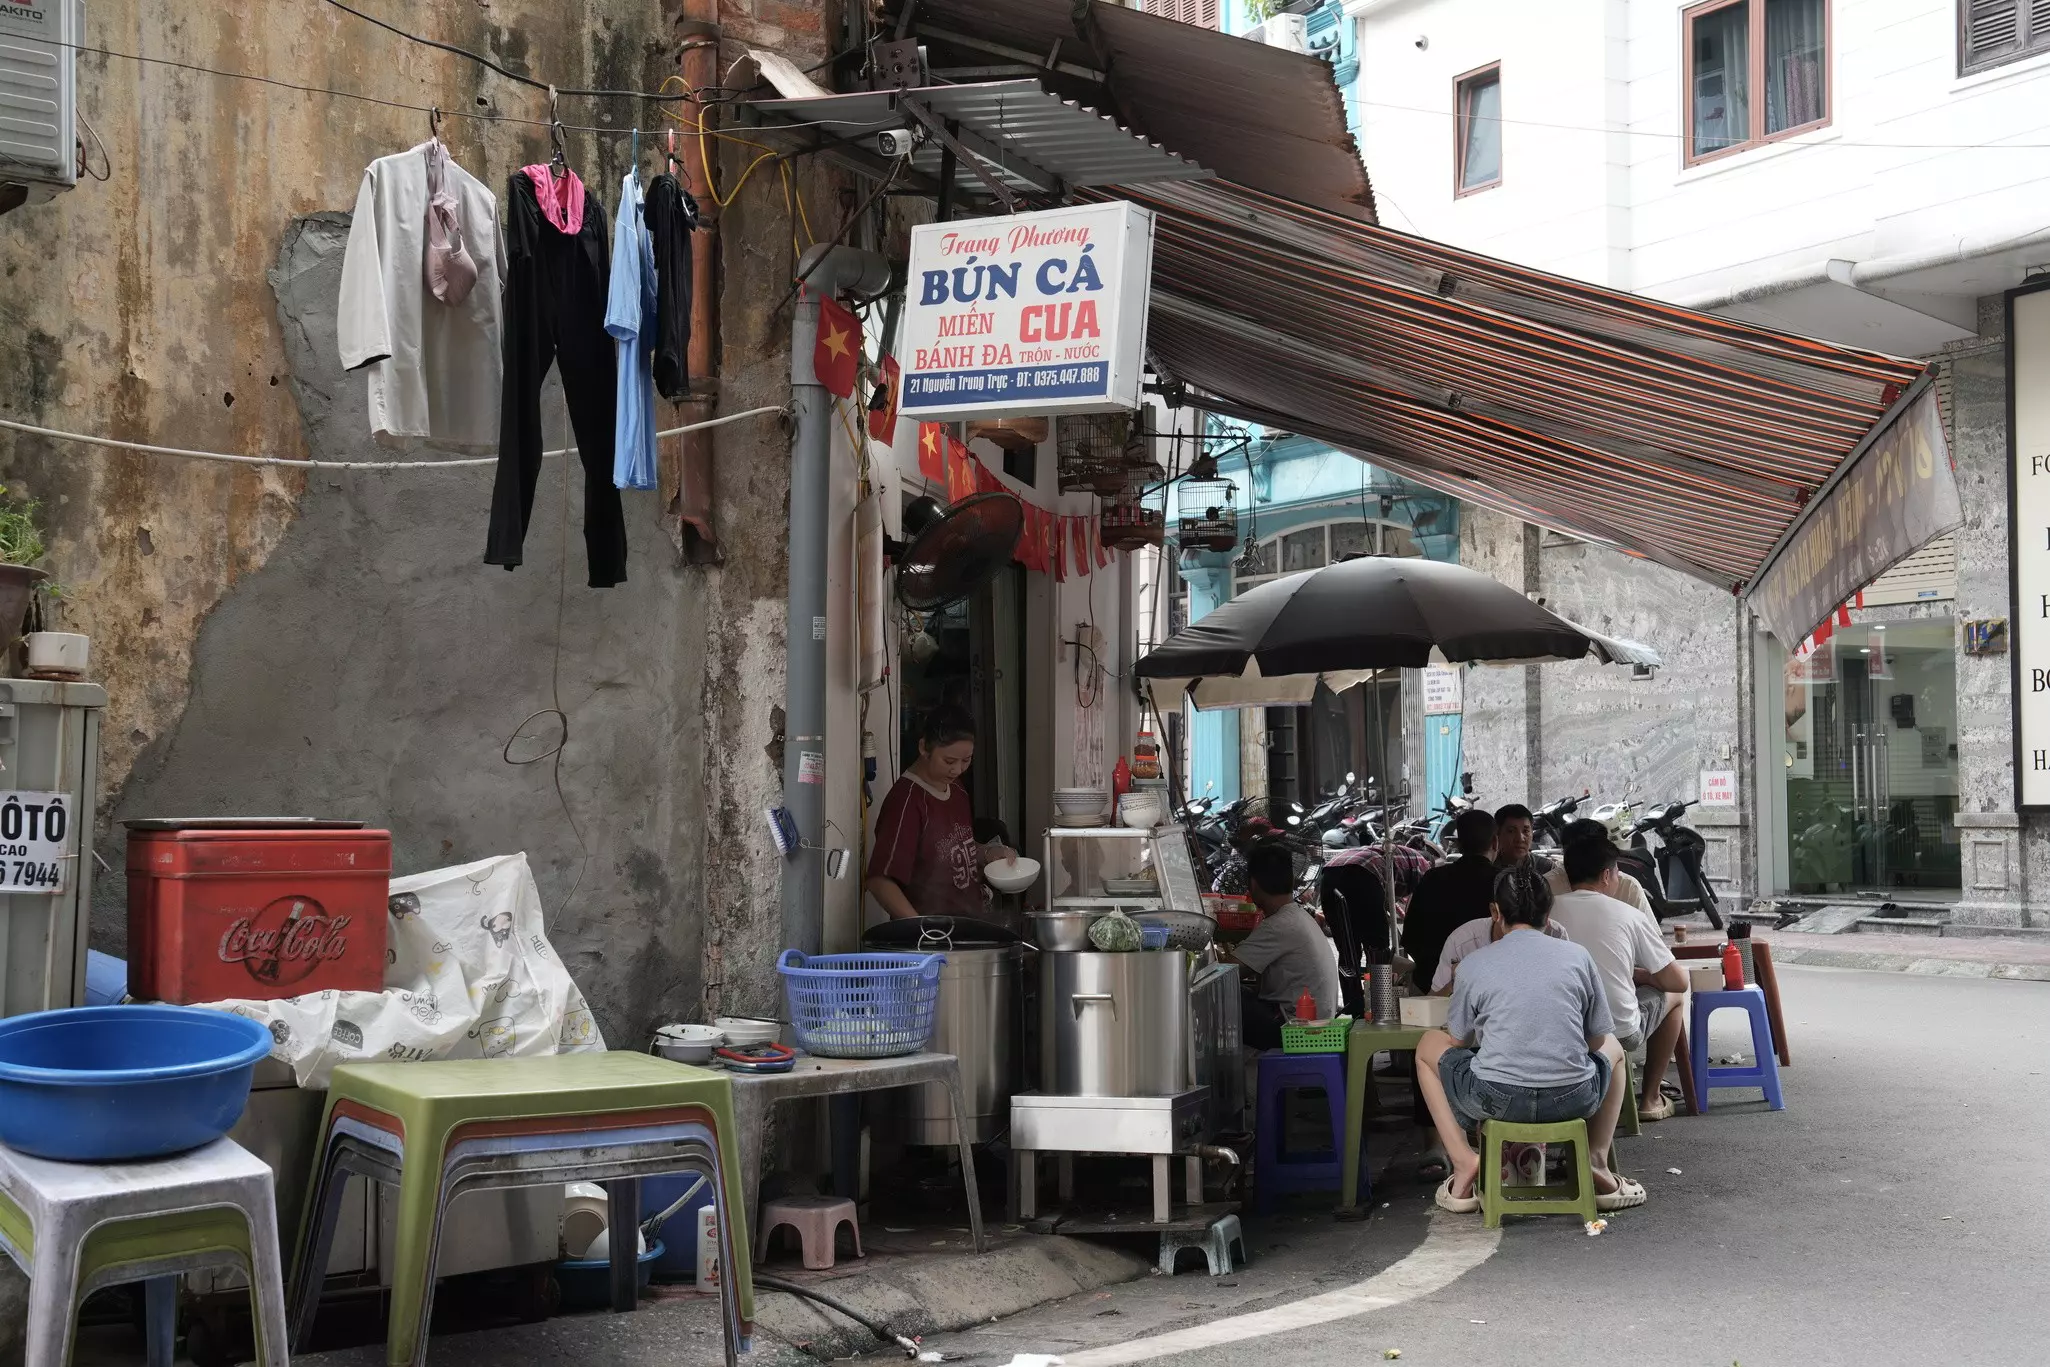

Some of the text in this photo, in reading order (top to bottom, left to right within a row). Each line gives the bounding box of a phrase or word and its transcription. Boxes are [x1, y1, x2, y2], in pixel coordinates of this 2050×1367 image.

[940, 224, 1090, 257] Trang Phương
[919, 243, 1104, 306] BÚN CÁ
[937, 301, 995, 338] MIẾN
[1019, 300, 1101, 343] CUA
[914, 340, 976, 371] BÁNH
[981, 343, 1014, 366] ĐA
[1019, 348, 1053, 365] TRỘN
[1064, 342, 1100, 361] NƯỚC
[910, 380, 920, 394] 21
[922, 373, 956, 394] Nguyễn
[958, 374, 985, 391] Trung
[987, 373, 1008, 393] Trực
[1016, 370, 1032, 388] ĐT:
[1033, 366, 1100, 387] 0375.447.888
[12, 861, 60, 887] 7944
[333, 1026, 361, 1044] COFFEE
